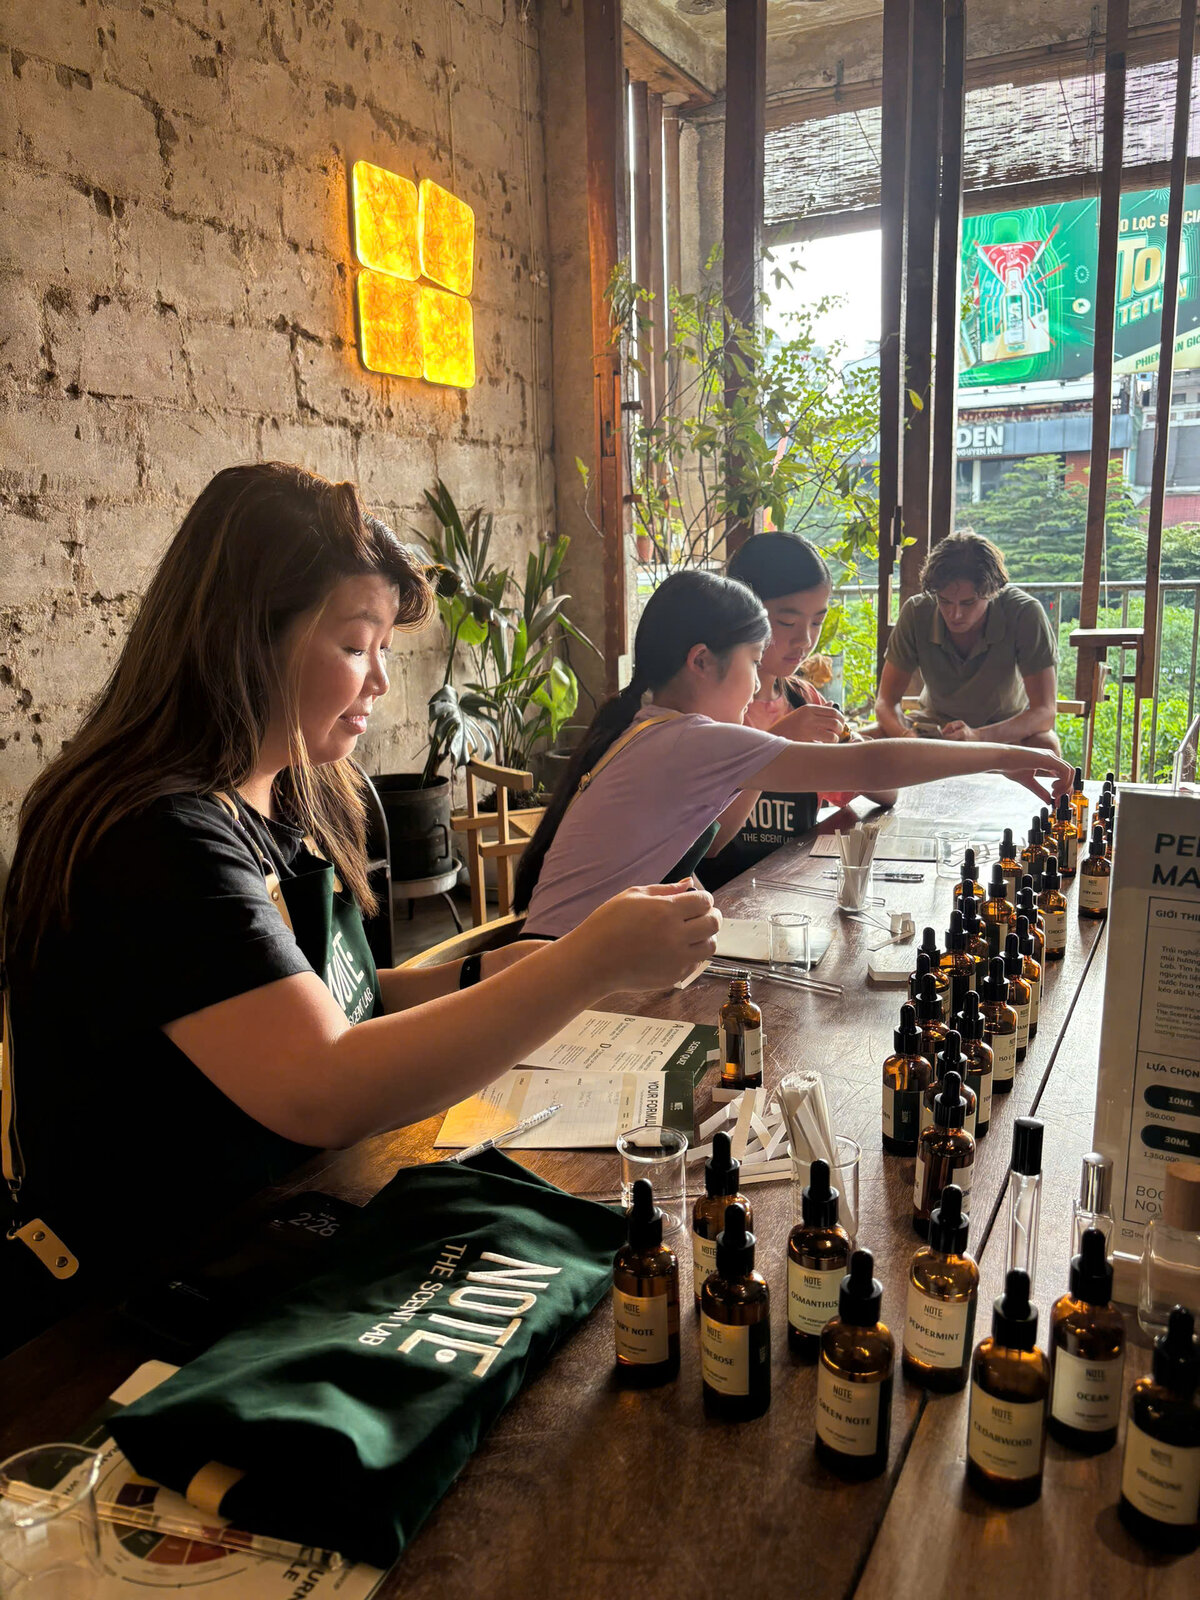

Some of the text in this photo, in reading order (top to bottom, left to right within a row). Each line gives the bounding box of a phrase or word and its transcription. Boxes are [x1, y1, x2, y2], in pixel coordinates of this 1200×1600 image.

[742, 833, 758, 842] THE
[760, 833, 782, 843] SCENT
[1155, 833, 1200, 857] PE
[361, 987, 374, 1009] LAB
[645, 1080, 659, 1126] YOUR FORMUL
[1168, 1096, 1194, 1107] 10ML
[1164, 1135, 1190, 1147] 30ML
[288, 1212, 340, 1237] 2:28
[804, 1275, 822, 1287] NOTE
[357, 1244, 468, 1347] THE SCENT LAB
[791, 1290, 839, 1308] OSMANTHUS
[397, 1251, 563, 1378] NOTE
[623, 1302, 640, 1314] NOTE
[924, 1304, 943, 1318] NOTE
[631, 1328, 655, 1337] NOTE
[909, 1315, 960, 1341] PEPPERMINT
[833, 1384, 852, 1400] NOTE
[1076, 1392, 1110, 1402] OCEAN
[845, 1415, 872, 1425] NOTE
[974, 1421, 1032, 1447] CEDARWOOD
